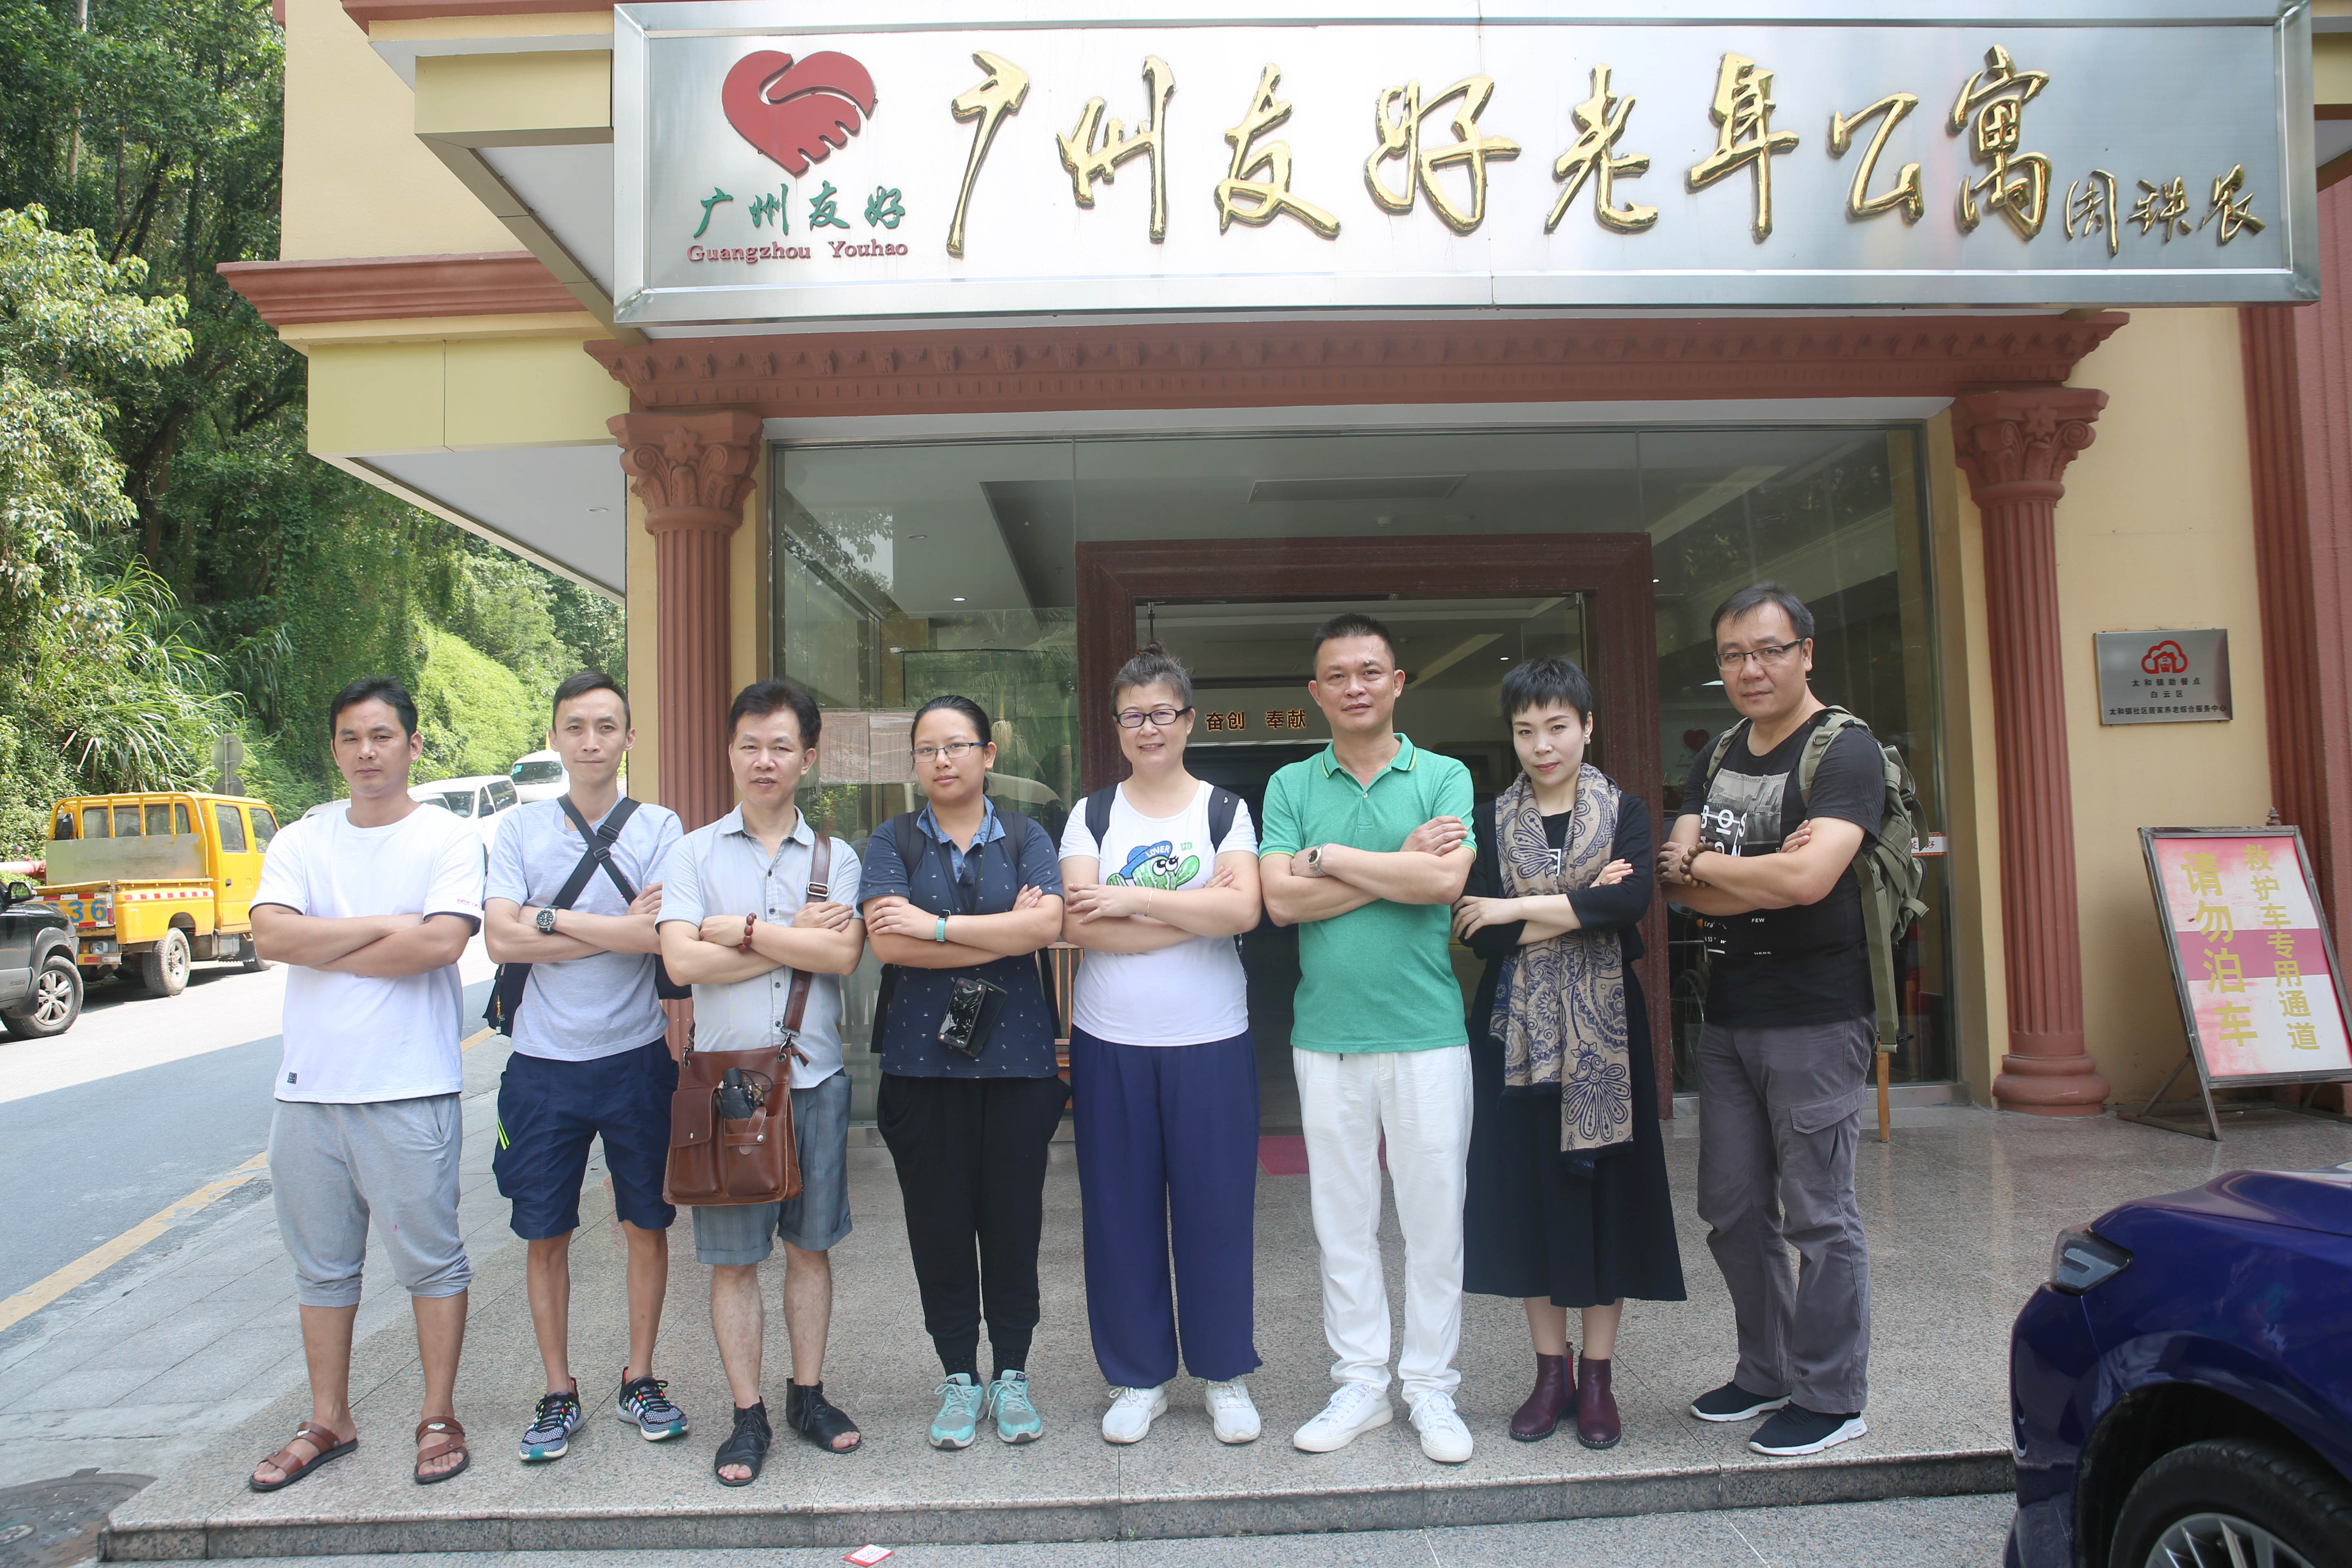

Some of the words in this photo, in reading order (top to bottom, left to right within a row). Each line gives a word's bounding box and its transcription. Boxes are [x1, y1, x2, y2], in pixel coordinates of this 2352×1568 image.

[946, 43, 2054, 258] 广州友好老年公寓
[693, 180, 906, 238] 广州友好
[686, 241, 811, 264] Guangzhou
[827, 238, 909, 258] Youhao
[2132, 677, 2201, 687] 太和镇助餐点
[2150, 690, 2184, 699] 白云区
[1205, 712, 1245, 731] 奋创
[1266, 709, 1306, 729] 奉献
[2109, 704, 2227, 715] 太和镇社区居家养老综合服务中心
[1145, 845, 1171, 858] LOVER
[2180, 851, 2258, 1047] 请勿泊车
[2242, 844, 2320, 1050] 救护车专用通道
